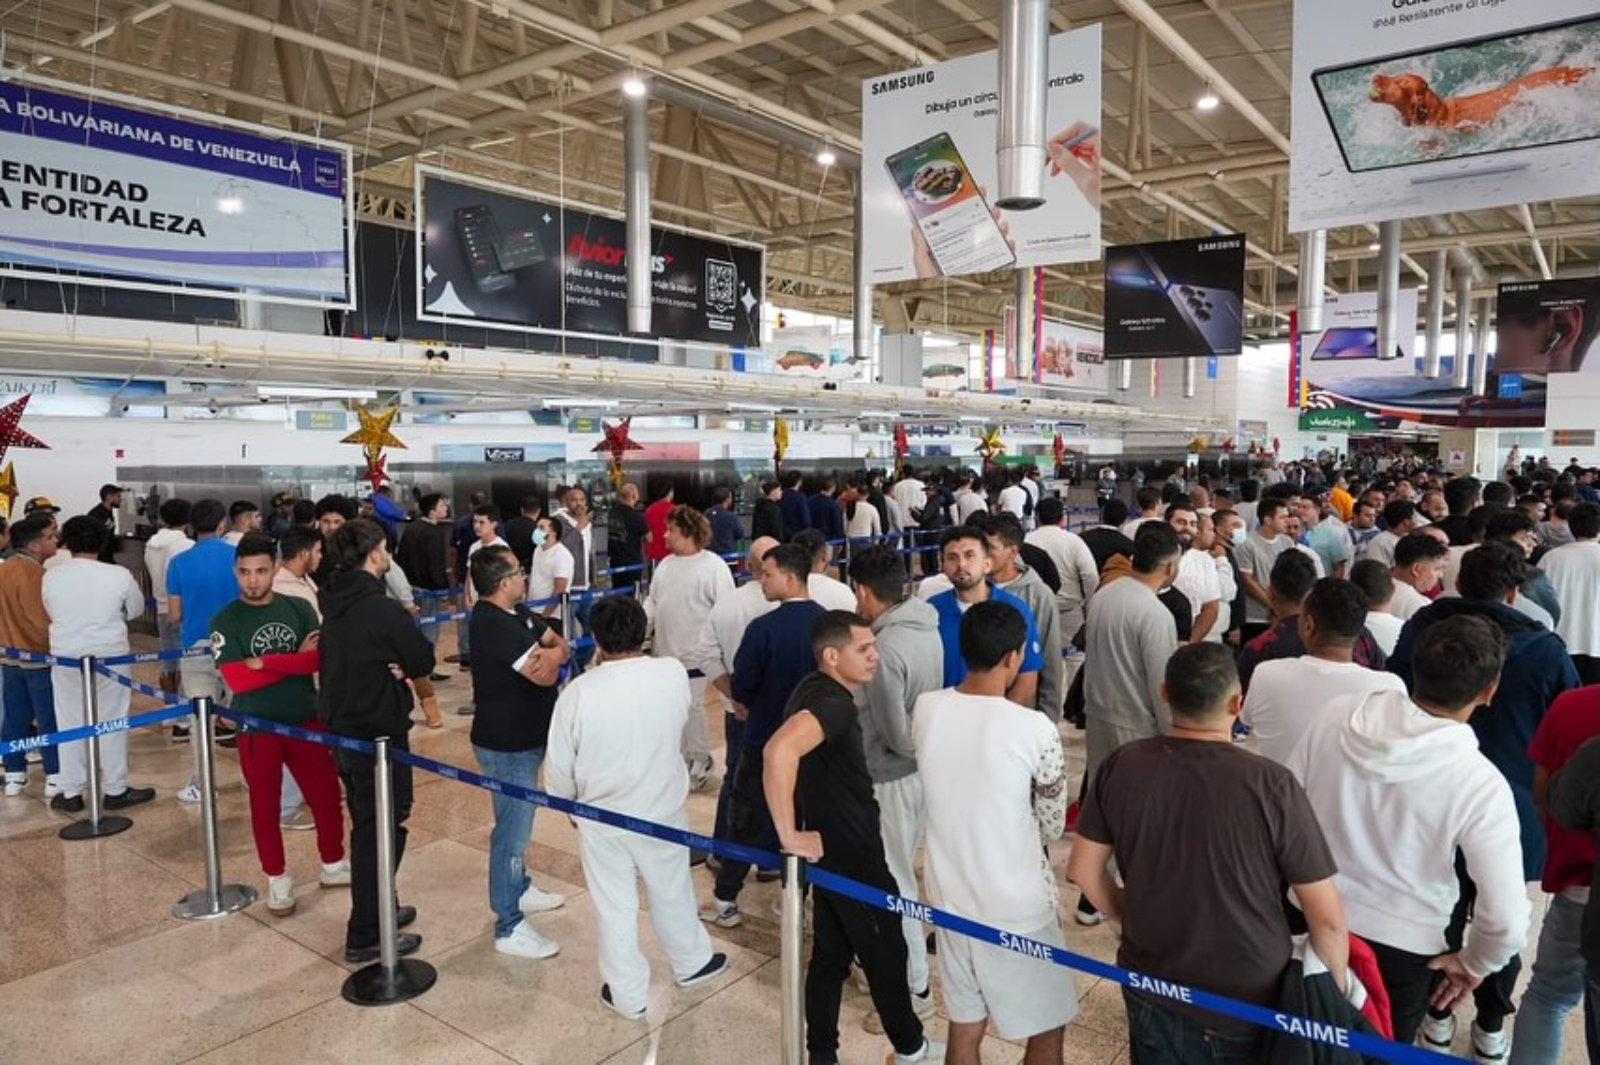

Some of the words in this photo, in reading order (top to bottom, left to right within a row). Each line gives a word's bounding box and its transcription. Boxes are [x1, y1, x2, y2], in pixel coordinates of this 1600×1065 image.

[1399, 3, 1463, 23] Resistente
[872, 70, 935, 95] SAMSUNG
[926, 100, 957, 115] Dibuja
[959, 97, 971, 107] un
[1048, 73, 1084, 88] ntralo
[17, 101, 165, 145] BOLIVARIANA
[170, 134, 194, 151] DE
[197, 141, 302, 174] VENEZUELA
[1, 159, 149, 203] ENTIDAD
[21, 190, 207, 238] FORTALEZA
[1198, 240, 1240, 252] SAMSUNG
[94, 717, 130, 736] SAIME
[9, 734, 50, 753] SAIME
[886, 894, 934, 924] SAIME
[999, 930, 1053, 961] SAIME
[1127, 971, 1193, 1004] SAIME
[1274, 1013, 1350, 1048] SAIME
